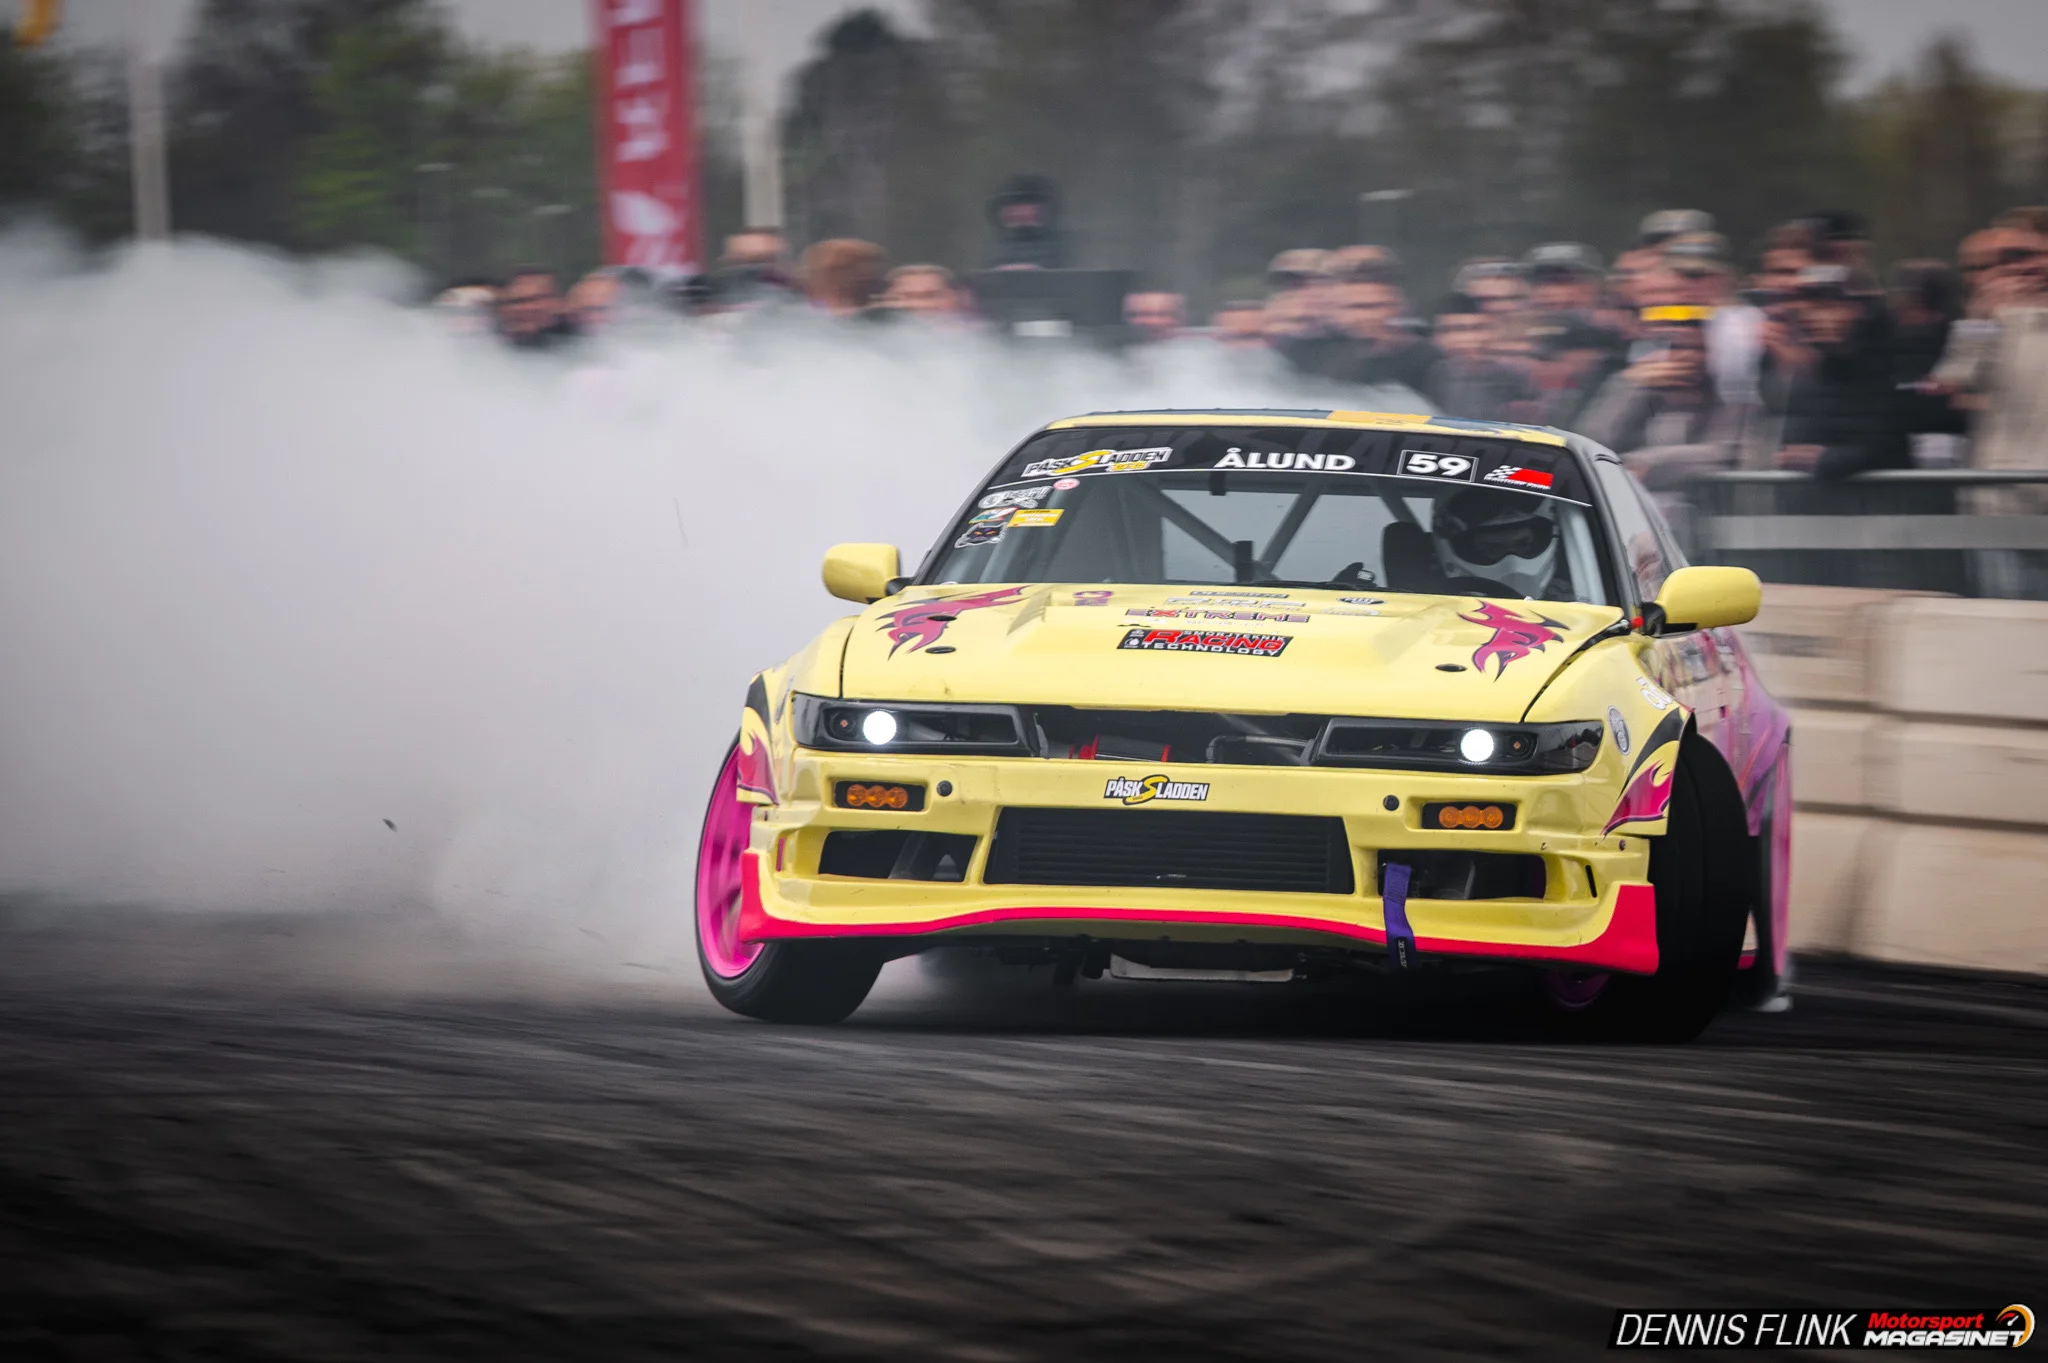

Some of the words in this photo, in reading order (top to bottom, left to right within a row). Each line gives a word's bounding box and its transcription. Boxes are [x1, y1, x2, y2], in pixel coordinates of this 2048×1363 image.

[1213, 447, 1356, 471] ÅLUND
[1405, 452, 1472, 477] 59
[1142, 642, 1279, 657] TECHNOLOGY
[1144, 629, 1285, 651] RACING
